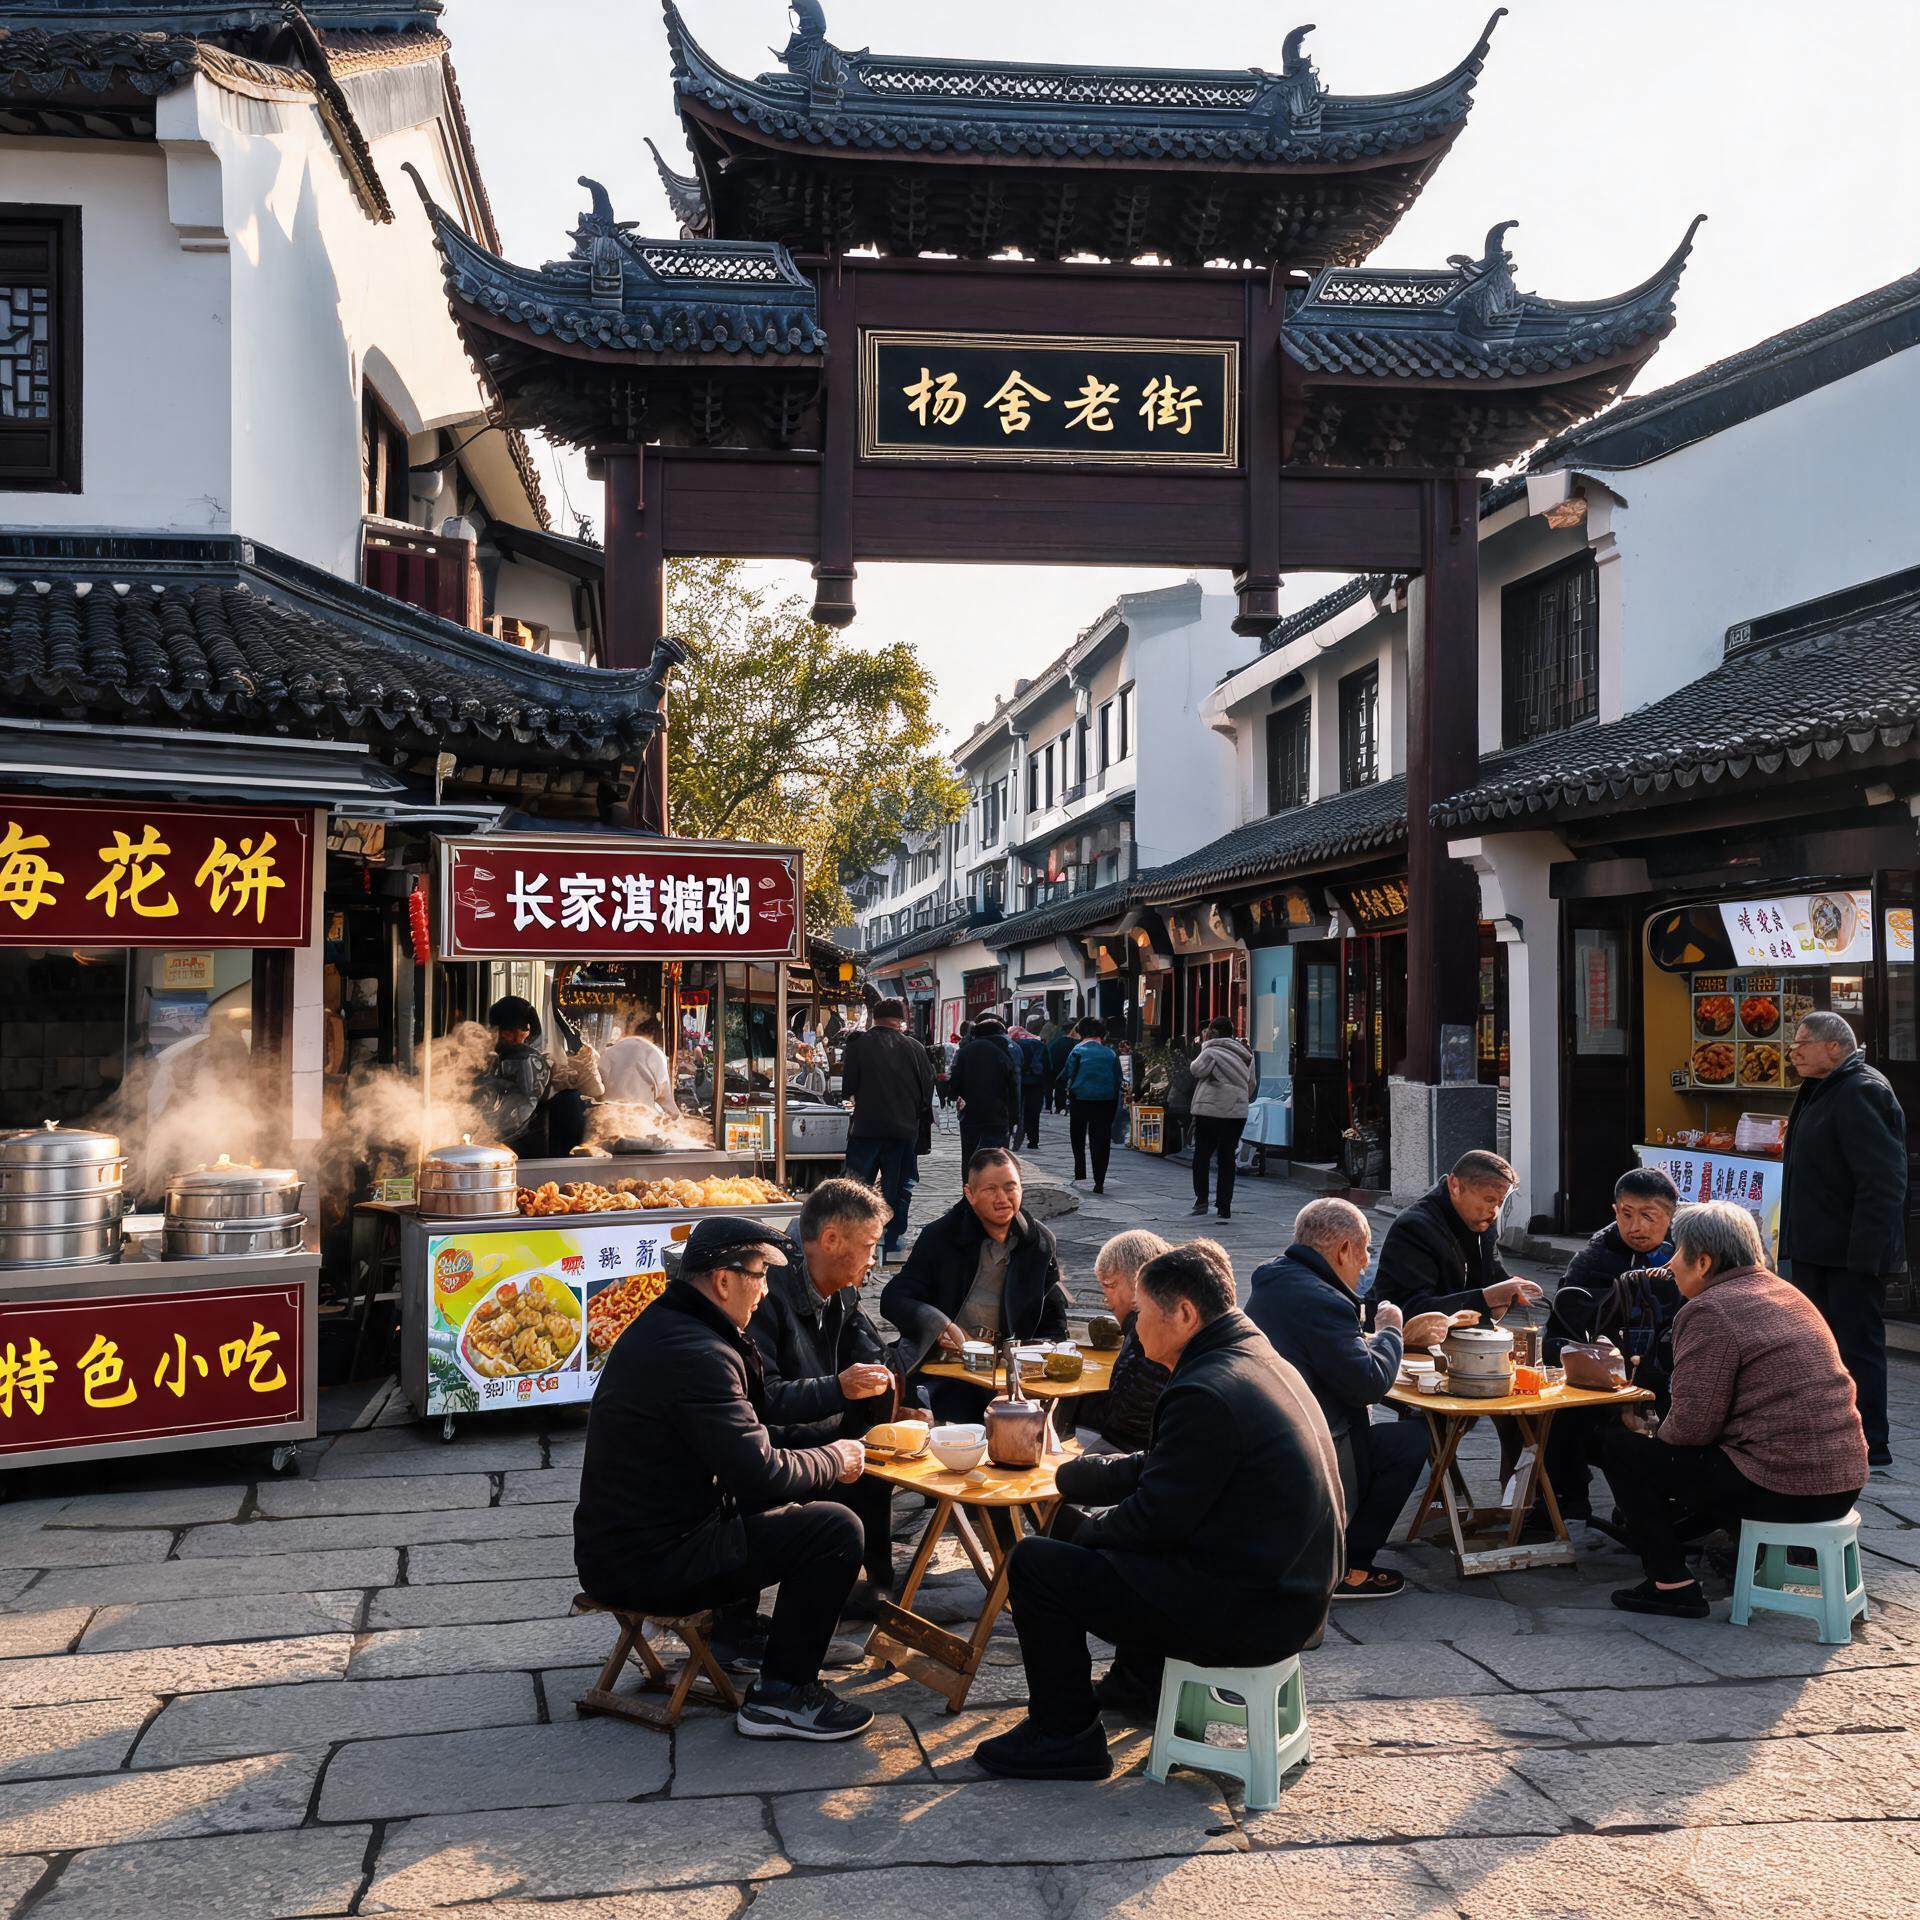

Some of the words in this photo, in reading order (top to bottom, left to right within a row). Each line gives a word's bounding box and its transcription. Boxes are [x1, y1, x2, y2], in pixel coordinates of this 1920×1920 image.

[902, 367, 1203, 435] 杨舍老街
[0, 1321, 287, 1418] 特色小吃
